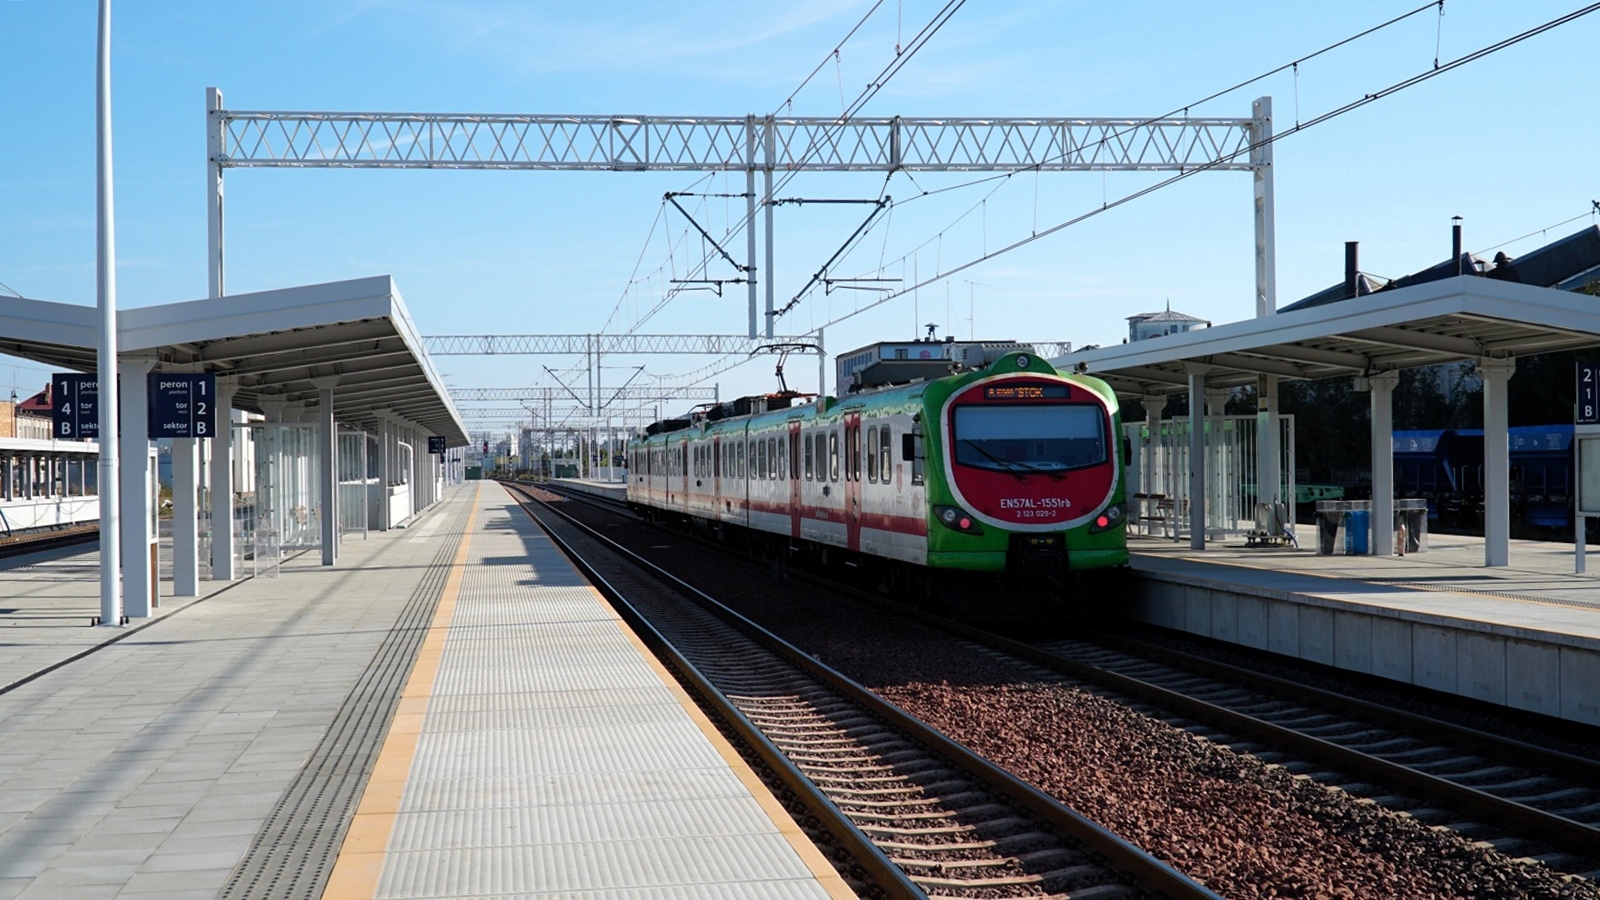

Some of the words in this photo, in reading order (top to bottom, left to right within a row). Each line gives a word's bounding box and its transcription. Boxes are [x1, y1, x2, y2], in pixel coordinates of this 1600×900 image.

[1583, 368, 1592, 382] 2
[60, 381, 68, 396] 1
[80, 381, 99, 390] per
[160, 381, 188, 390] peron
[198, 381, 206, 396] 1
[1586, 388, 1591, 399] 1
[61, 402, 72, 415] 4
[197, 402, 207, 415] 2
[1585, 405, 1593, 417] B
[61, 421, 71, 435] B
[80, 422, 99, 430] sekt
[163, 422, 188, 430] sektor
[196, 421, 207, 435] B
[1000, 498, 1071, 509] EN57AL-1551rb
[1016, 510, 1022, 518] 2
